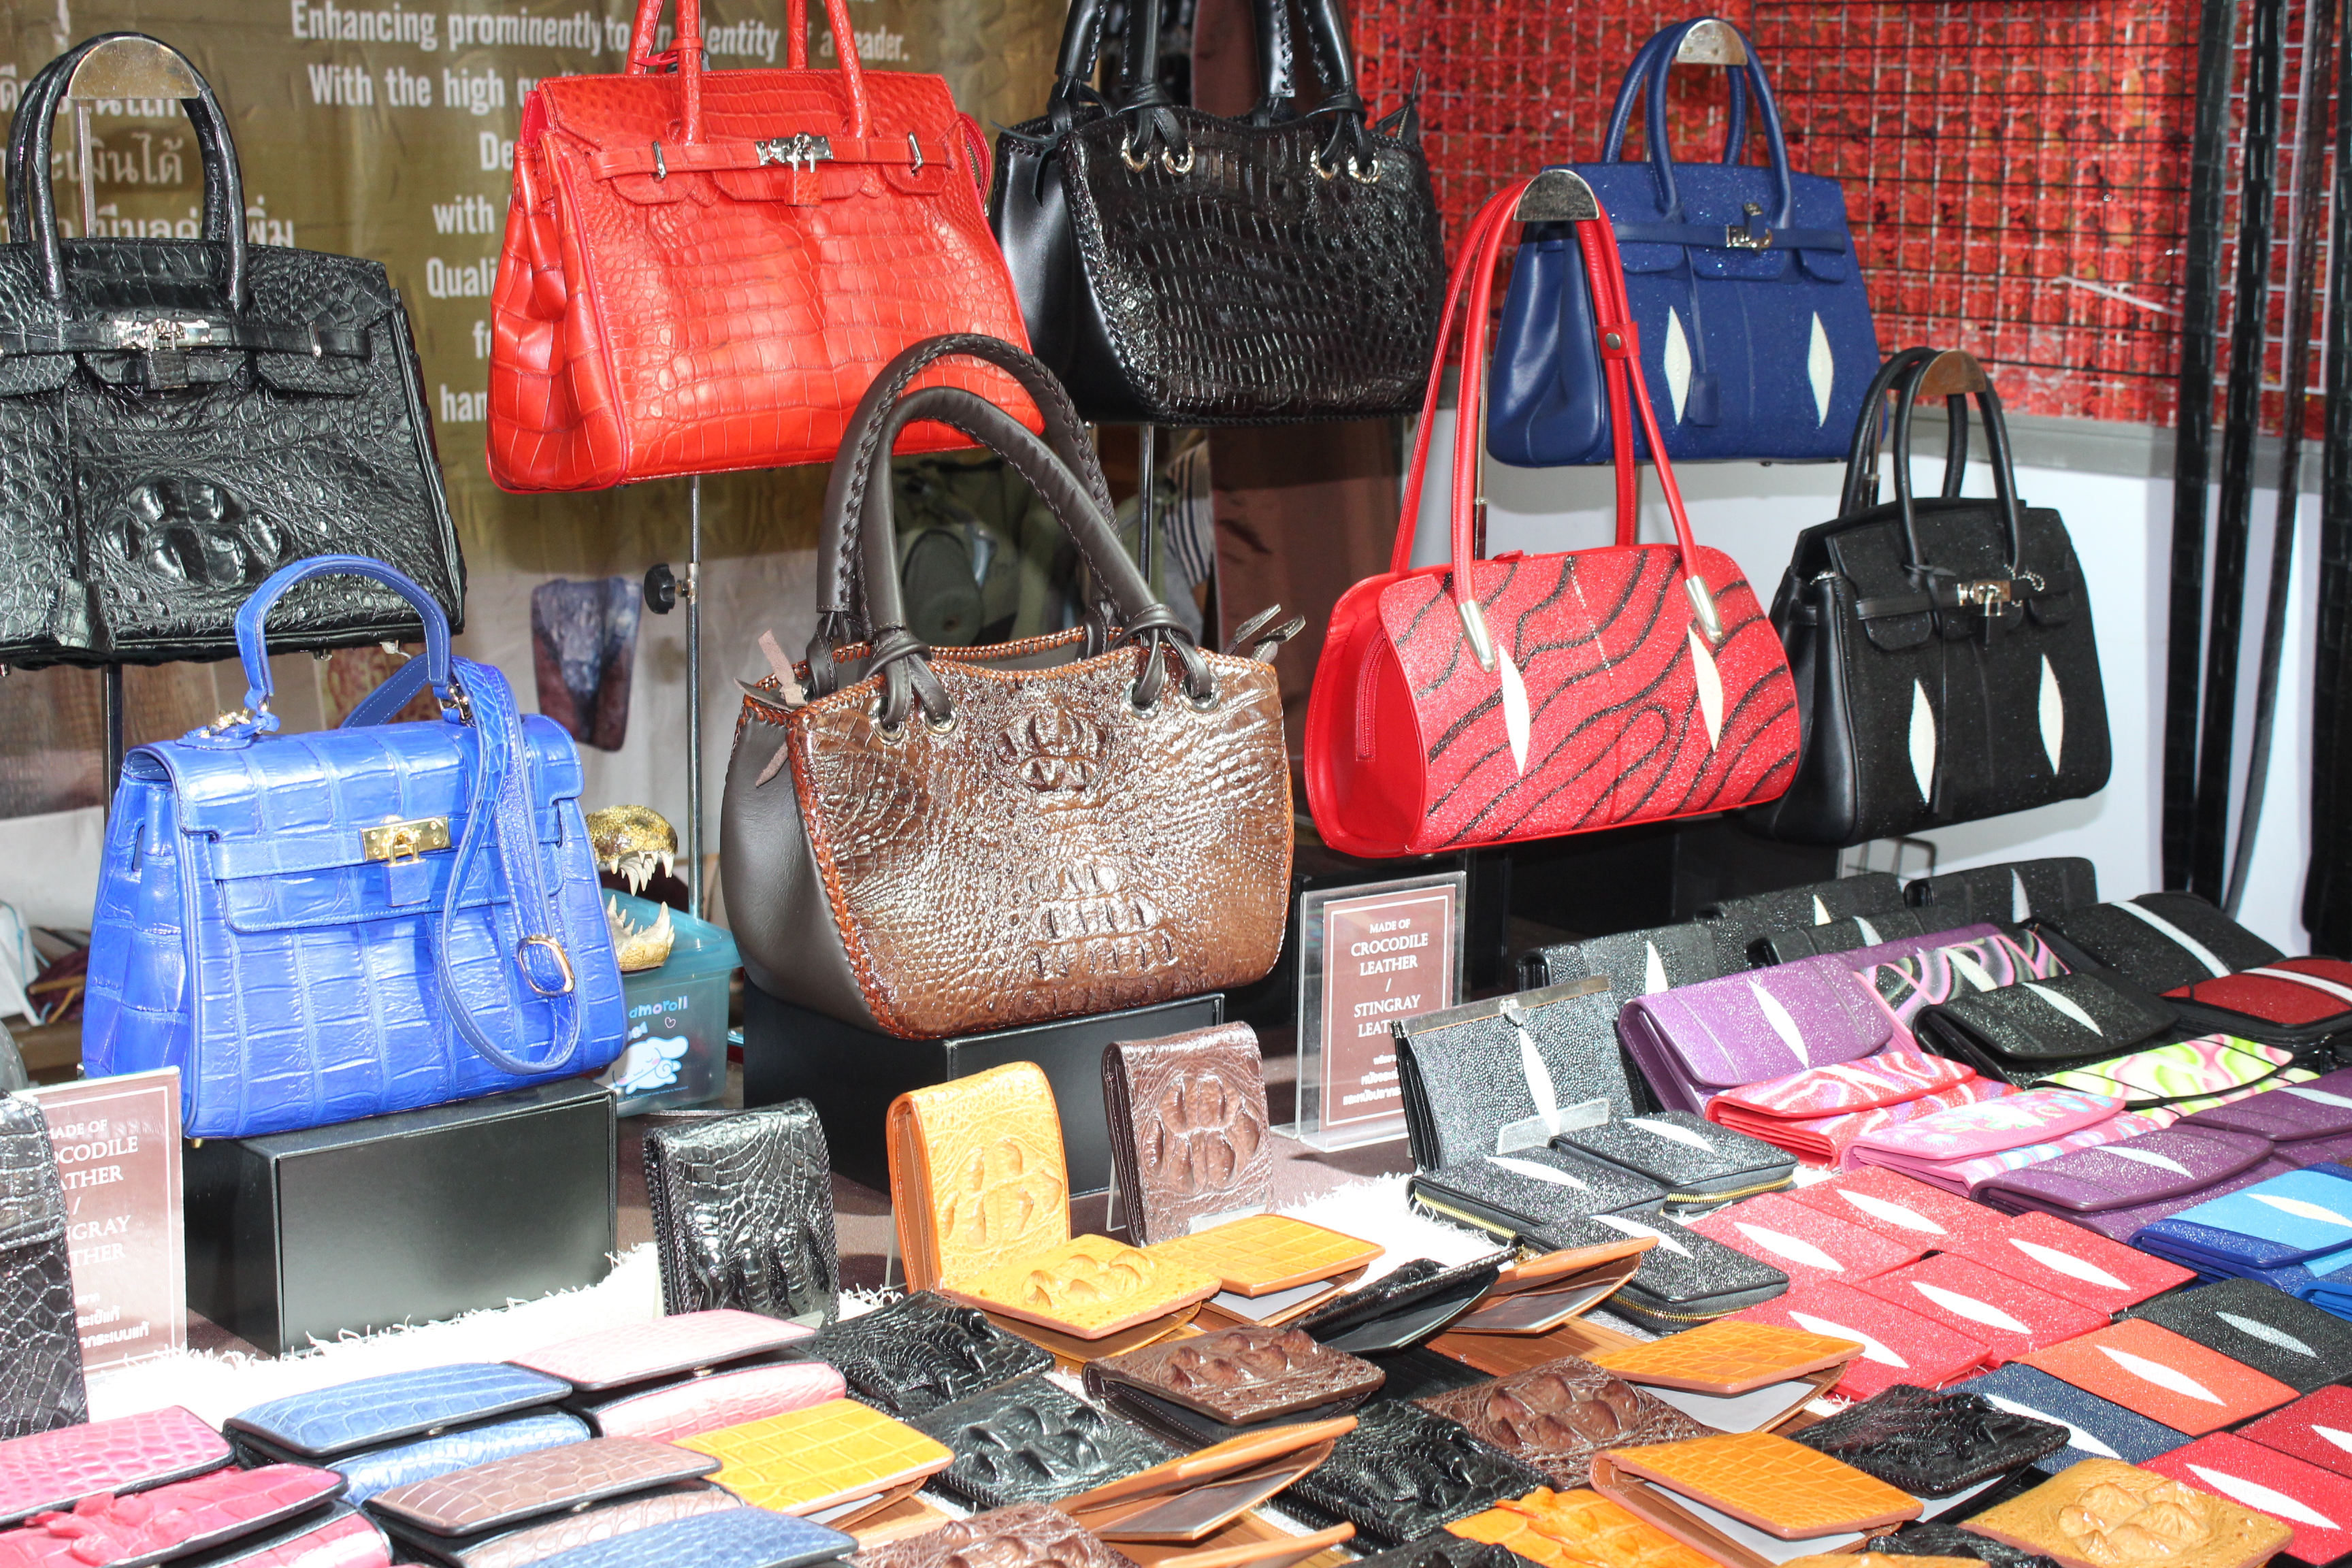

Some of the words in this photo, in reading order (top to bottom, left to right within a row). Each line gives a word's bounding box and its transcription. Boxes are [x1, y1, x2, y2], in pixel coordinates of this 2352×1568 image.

[291, 0, 438, 52] Enhancing
[447, 6, 602, 57] prominently
[604, 15, 630, 52] to
[854, 24, 910, 62] eader.
[308, 63, 373, 106] With
[385, 65, 432, 108] the
[443, 68, 506, 116] high
[478, 131, 514, 171] De
[432, 195, 495, 235] with
[426, 257, 497, 299] Quali
[440, 383, 487, 423] han
[1369, 920, 1396, 934] MADE
[1399, 918, 1411, 930] OF
[1351, 932, 1428, 957] CROCODILE
[1360, 955, 1418, 977] LEATHER
[629, 995, 688, 1019] amoroll
[1354, 994, 1421, 1018] STINGRAY
[1358, 1019, 1392, 1038] LEAT
[88, 1119, 108, 1133] OF
[69, 1243, 127, 1268] THER
[77, 1305, 120, 1328] ระเข้แท้
[80, 1321, 150, 1348] ากระเบนแท้
